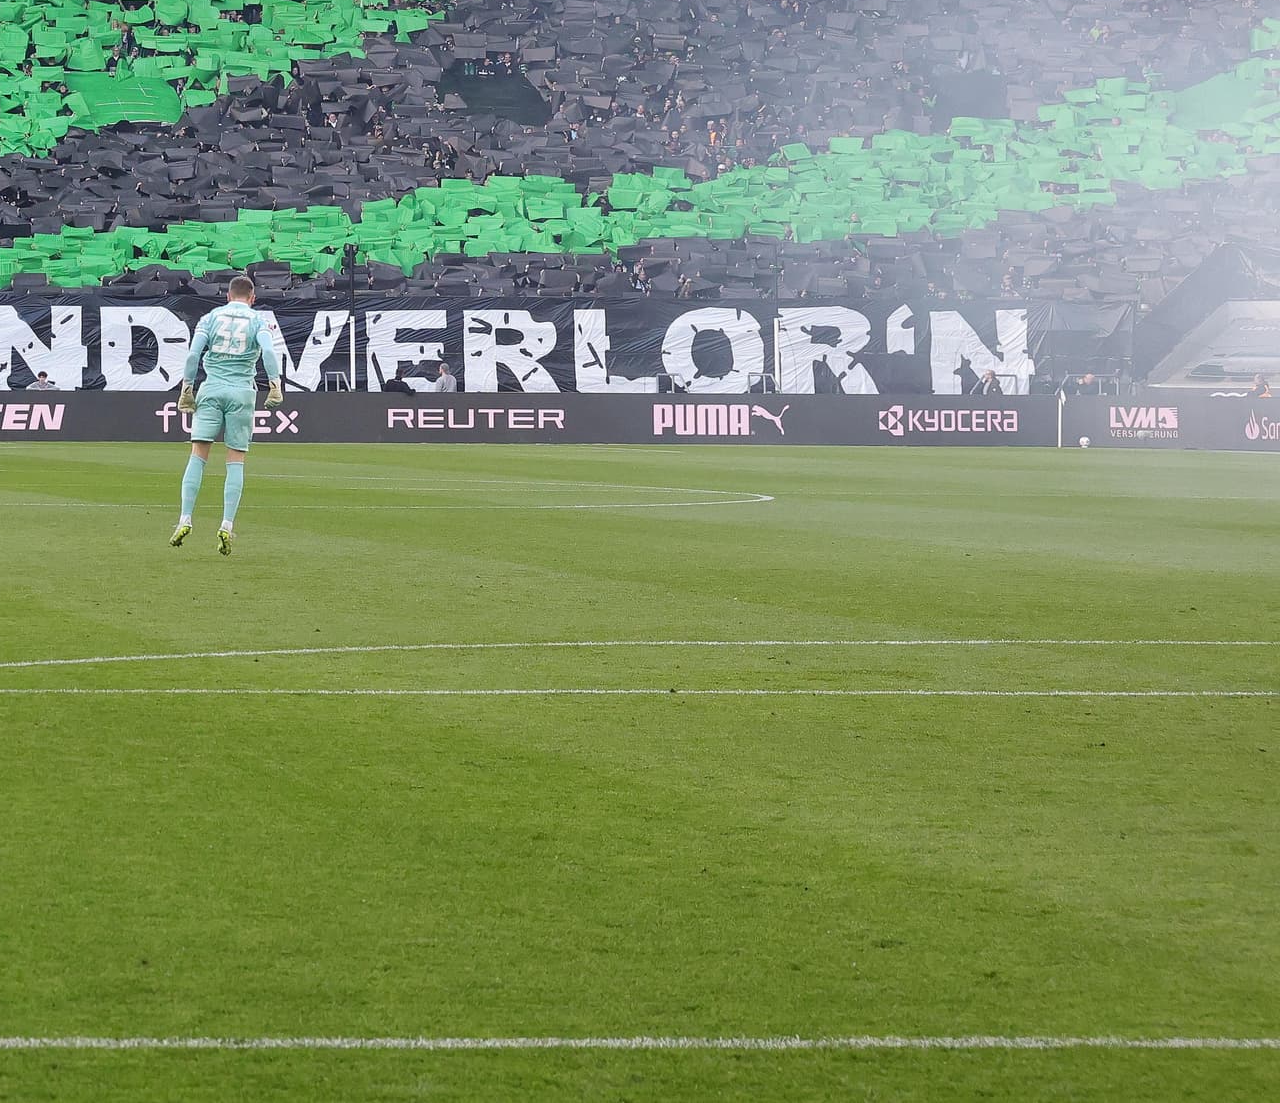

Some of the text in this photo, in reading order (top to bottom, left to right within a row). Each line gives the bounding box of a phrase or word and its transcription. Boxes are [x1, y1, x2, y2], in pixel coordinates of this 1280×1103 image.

[212, 315, 250, 355] 33
[387, 409, 565, 429] REUTER
[653, 404, 750, 435] PUMA
[908, 410, 1018, 432] KYOCERA
[1110, 407, 1156, 428] LVM
[1110, 430, 1179, 439] VERSIERUNG
